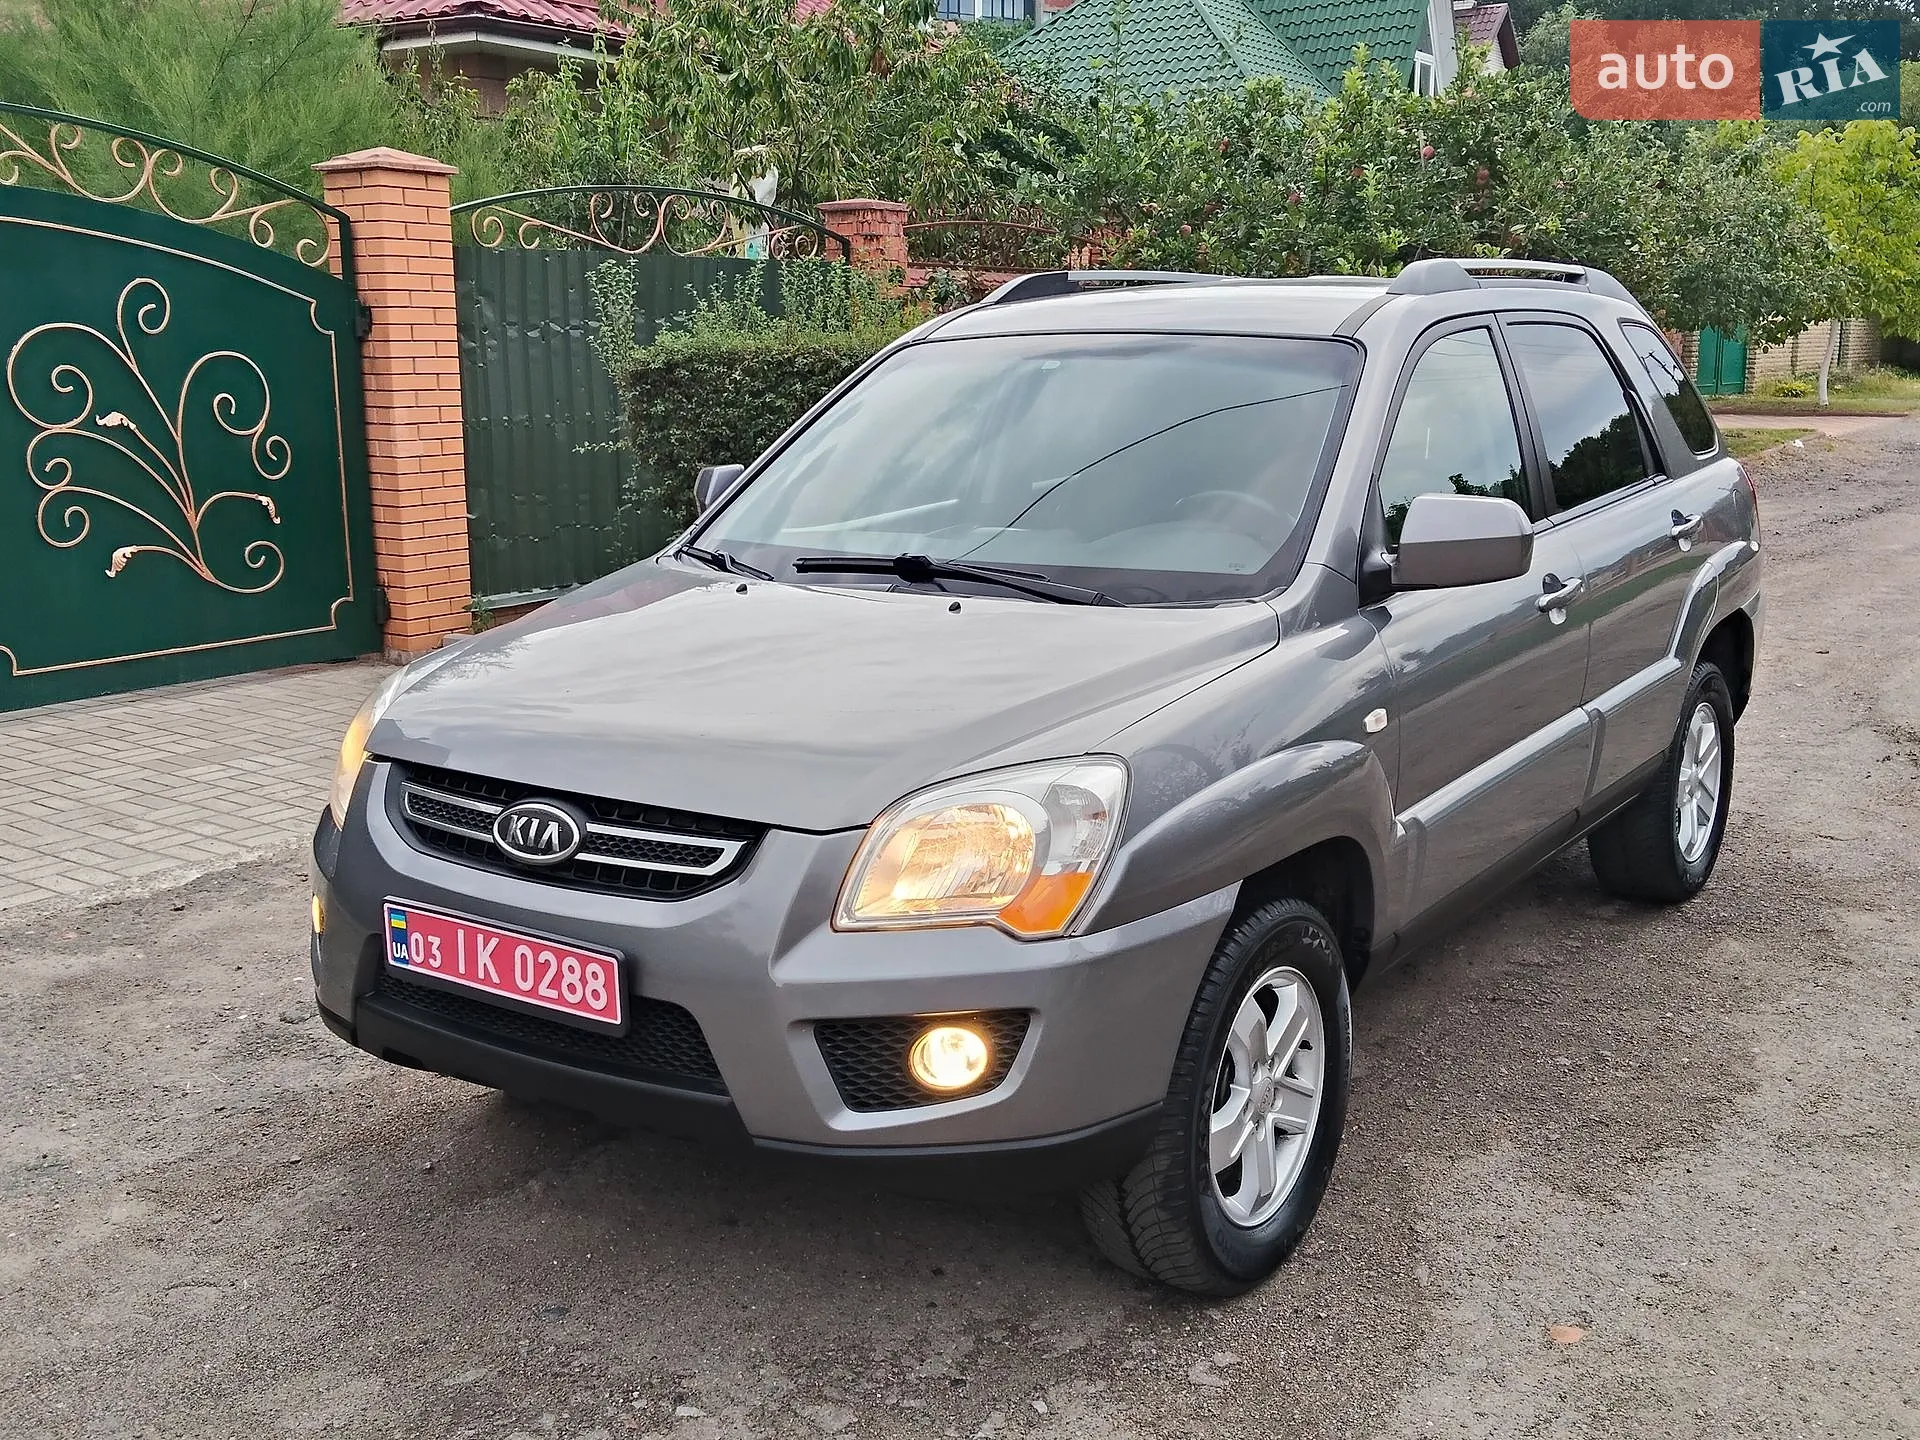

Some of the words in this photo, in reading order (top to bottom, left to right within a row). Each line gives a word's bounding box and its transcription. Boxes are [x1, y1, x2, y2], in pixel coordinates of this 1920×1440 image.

[505, 814, 560, 852] KIA
[392, 941, 409, 960] UA
[410, 931, 442, 968] 03
[457, 928, 500, 984] IK
[514, 944, 608, 1011] 0288
